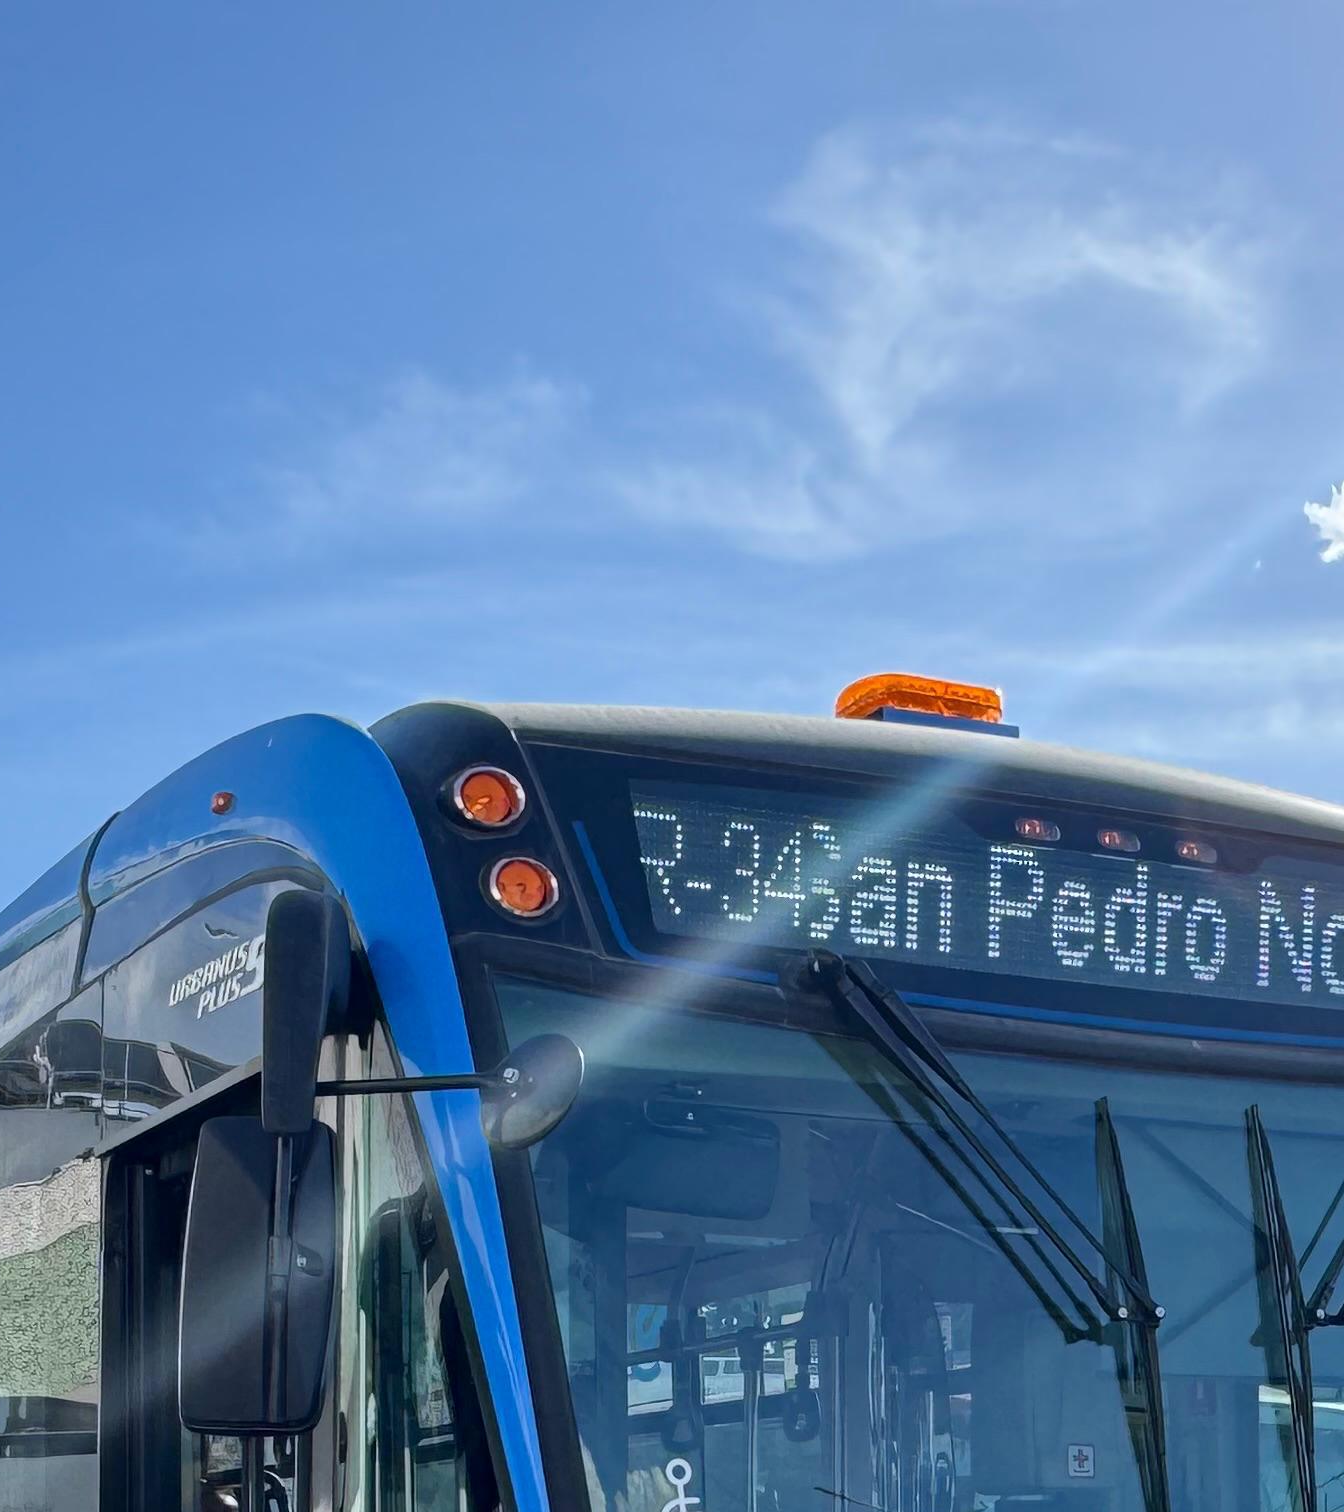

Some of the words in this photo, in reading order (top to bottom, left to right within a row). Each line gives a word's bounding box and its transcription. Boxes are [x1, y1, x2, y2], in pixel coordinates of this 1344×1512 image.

[633, 809, 806, 928] R-34
[987, 844, 1227, 981] Pedro
[196, 972, 244, 1020] PLUS
